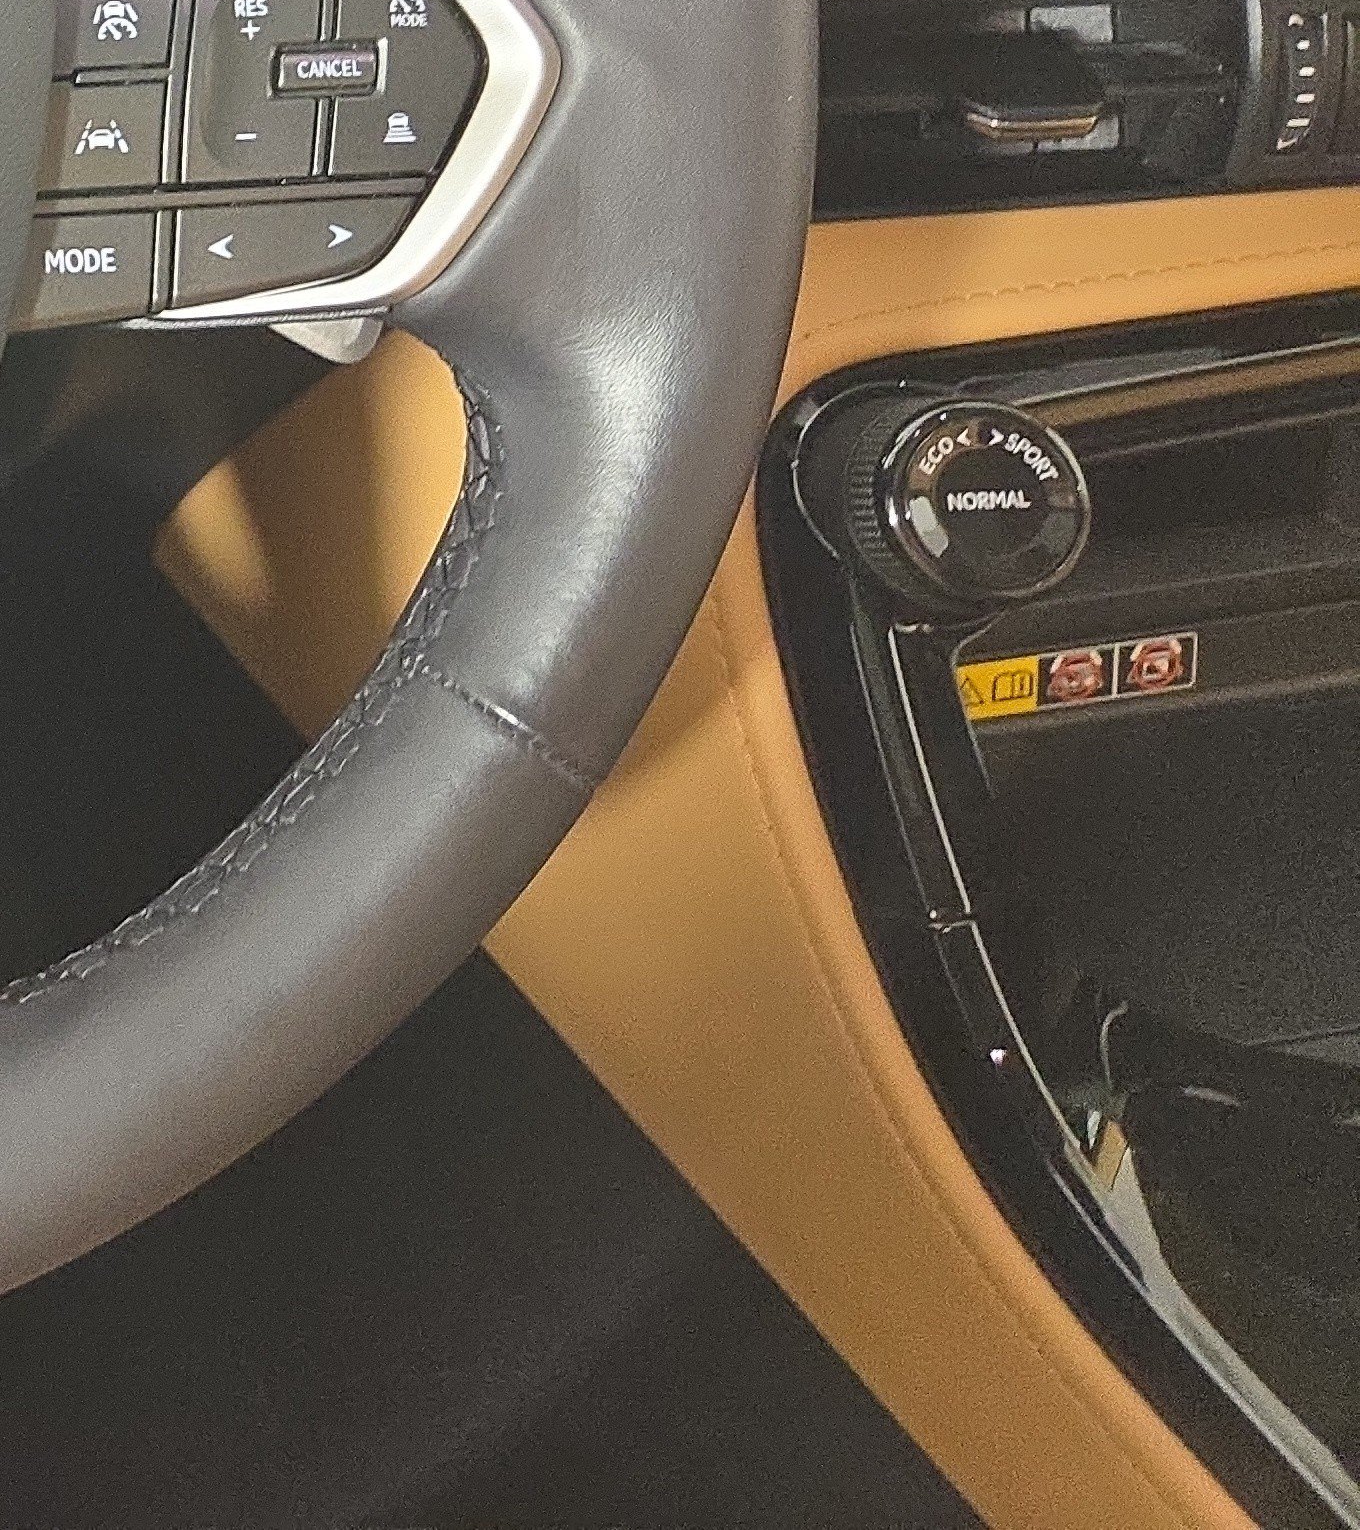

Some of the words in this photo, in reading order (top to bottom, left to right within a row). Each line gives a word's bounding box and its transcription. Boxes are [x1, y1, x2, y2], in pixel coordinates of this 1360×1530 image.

[390, 13, 428, 28] MODE
[296, 59, 363, 79] CANCEL
[44, 247, 117, 274] MODE
[919, 436, 954, 475] ECO
[1004, 433, 1059, 481] SPORT
[947, 489, 1032, 512] NORMAL
